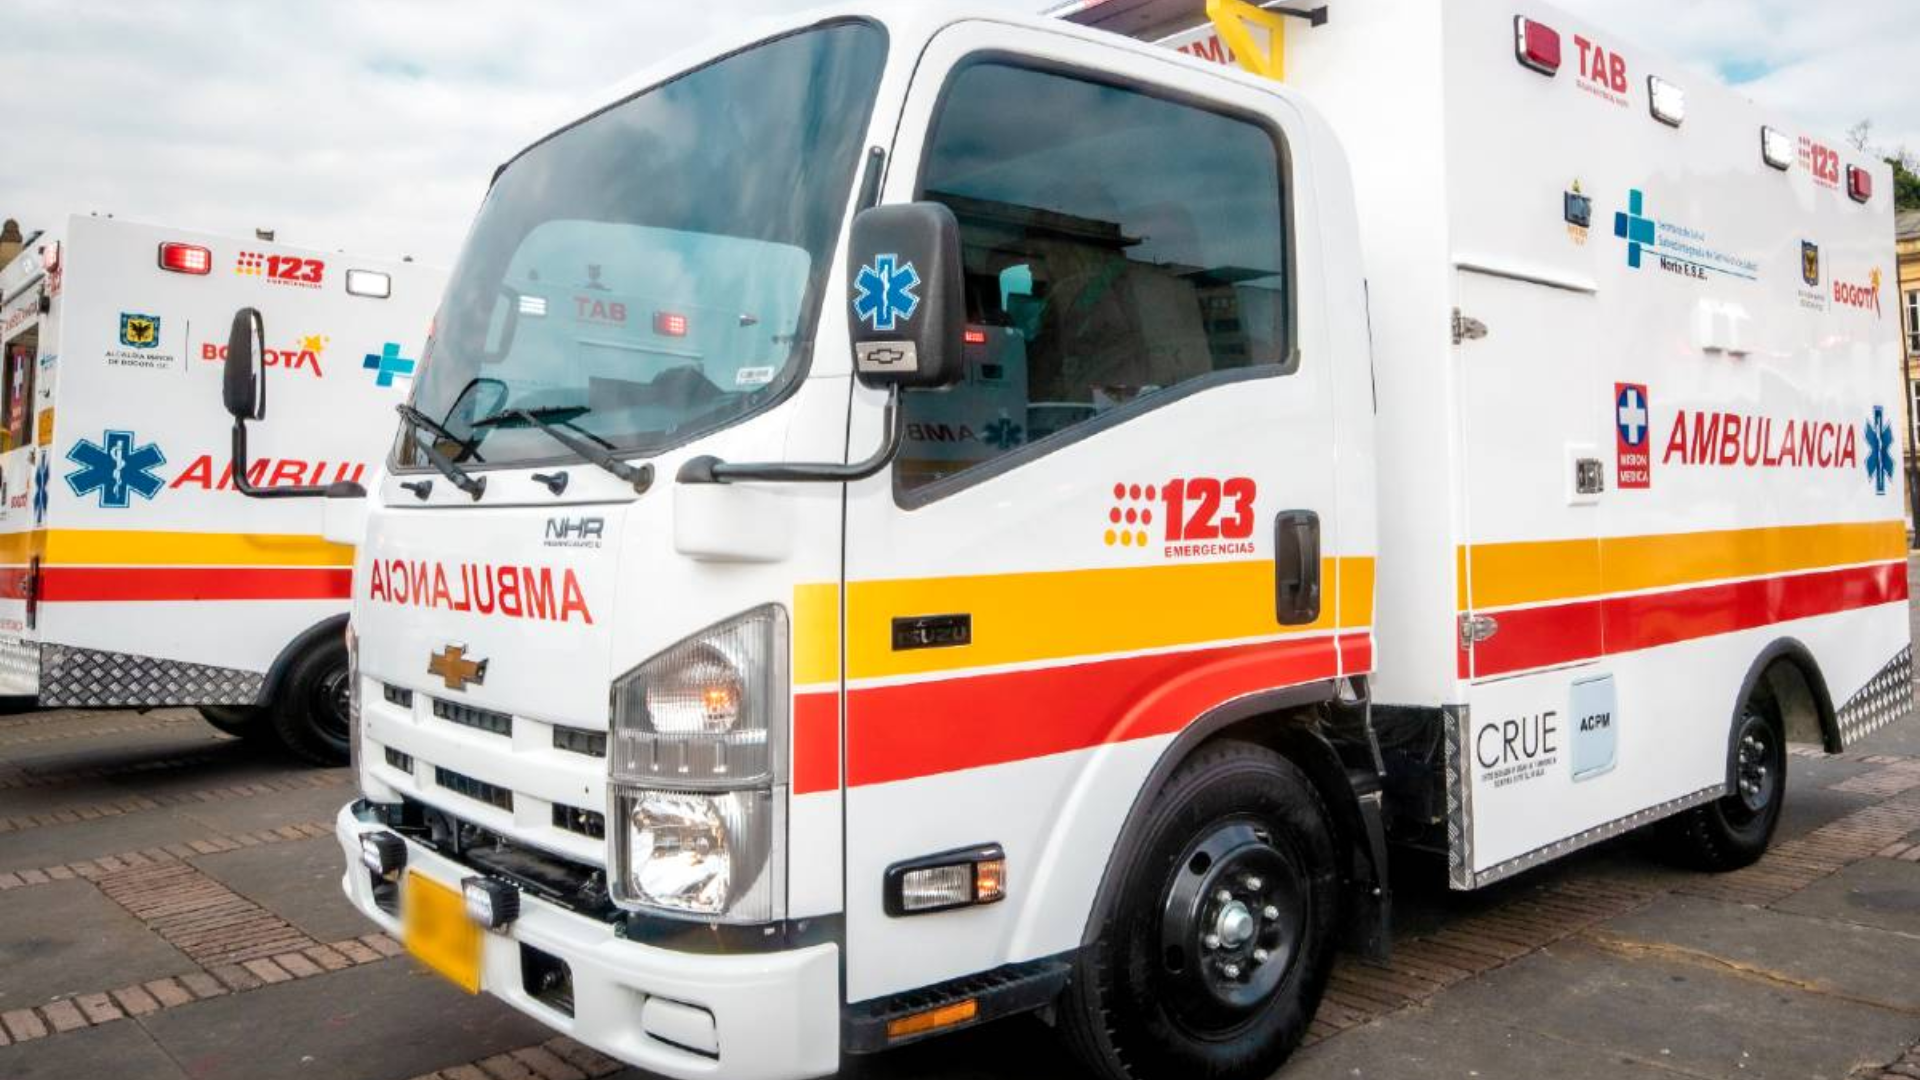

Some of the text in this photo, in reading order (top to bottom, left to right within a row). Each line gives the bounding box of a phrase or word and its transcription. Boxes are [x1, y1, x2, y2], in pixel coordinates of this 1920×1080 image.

[1574, 34, 1627, 94] TAB
[1811, 144, 1839, 183] 123
[266, 255, 325, 283] 123
[573, 296, 628, 322] TAB
[1662, 410, 1856, 468] AMBULANCIA
[1161, 477, 1257, 541] 123
[545, 517, 604, 539] NHR
[1164, 542, 1255, 558] EMERGENCIAS
[1580, 712, 1611, 732] ACPM
[1477, 711, 1557, 768] CRUE
